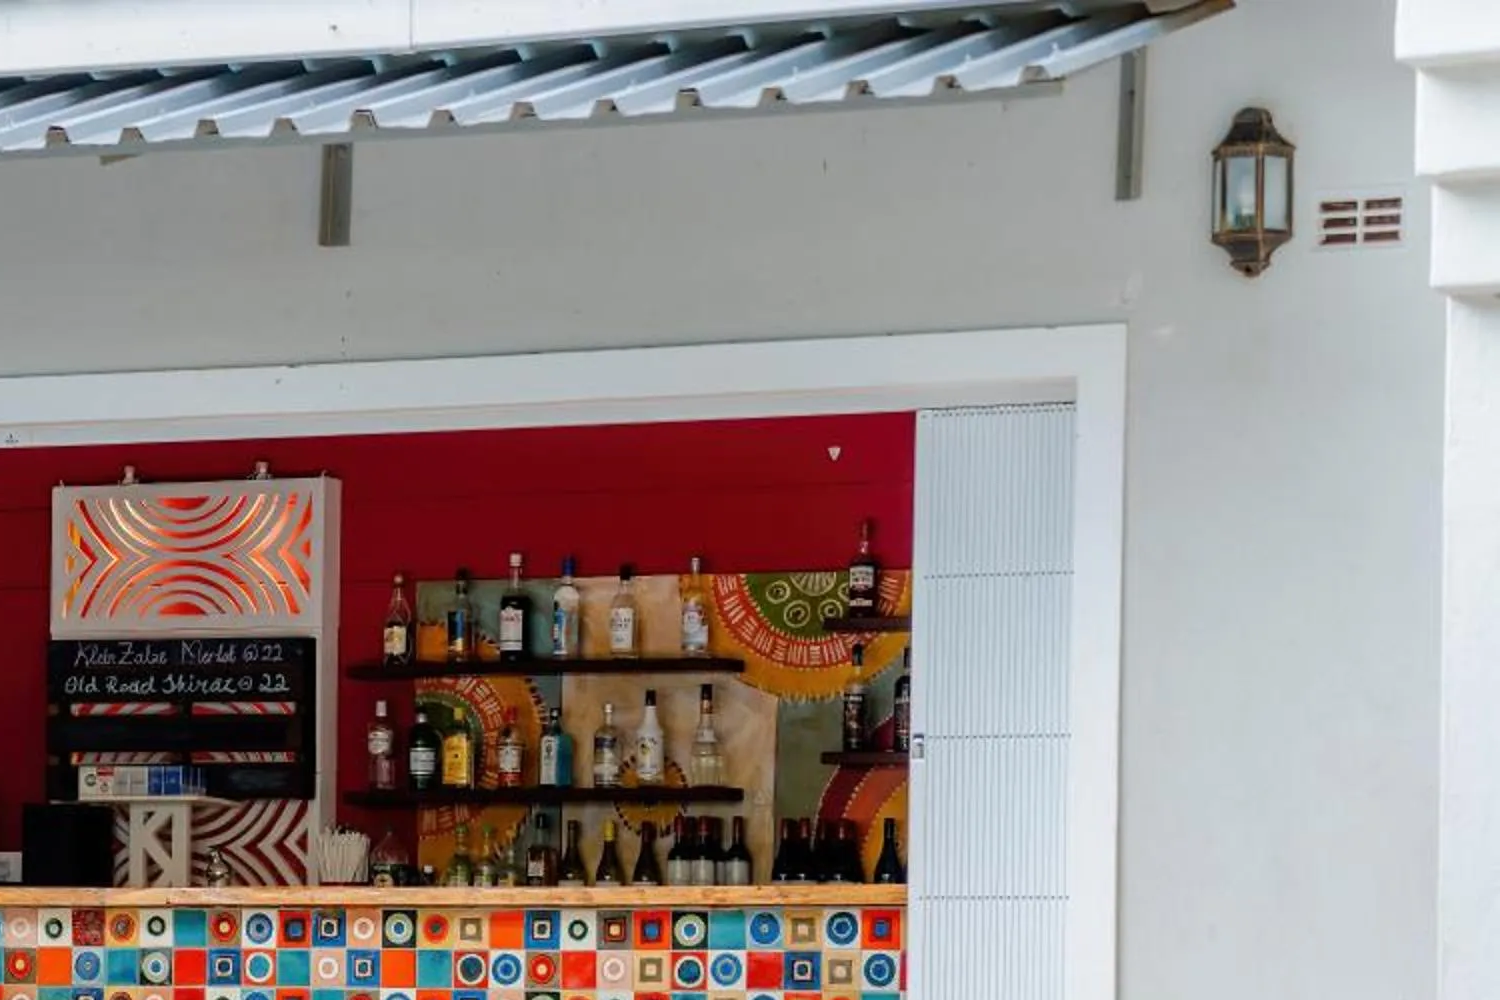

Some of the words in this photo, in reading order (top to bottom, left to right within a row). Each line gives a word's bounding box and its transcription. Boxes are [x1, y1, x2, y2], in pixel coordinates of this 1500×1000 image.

[64, 675, 100, 694] Old
[105, 675, 157, 695] Road
[161, 673, 237, 694] Shiraz
